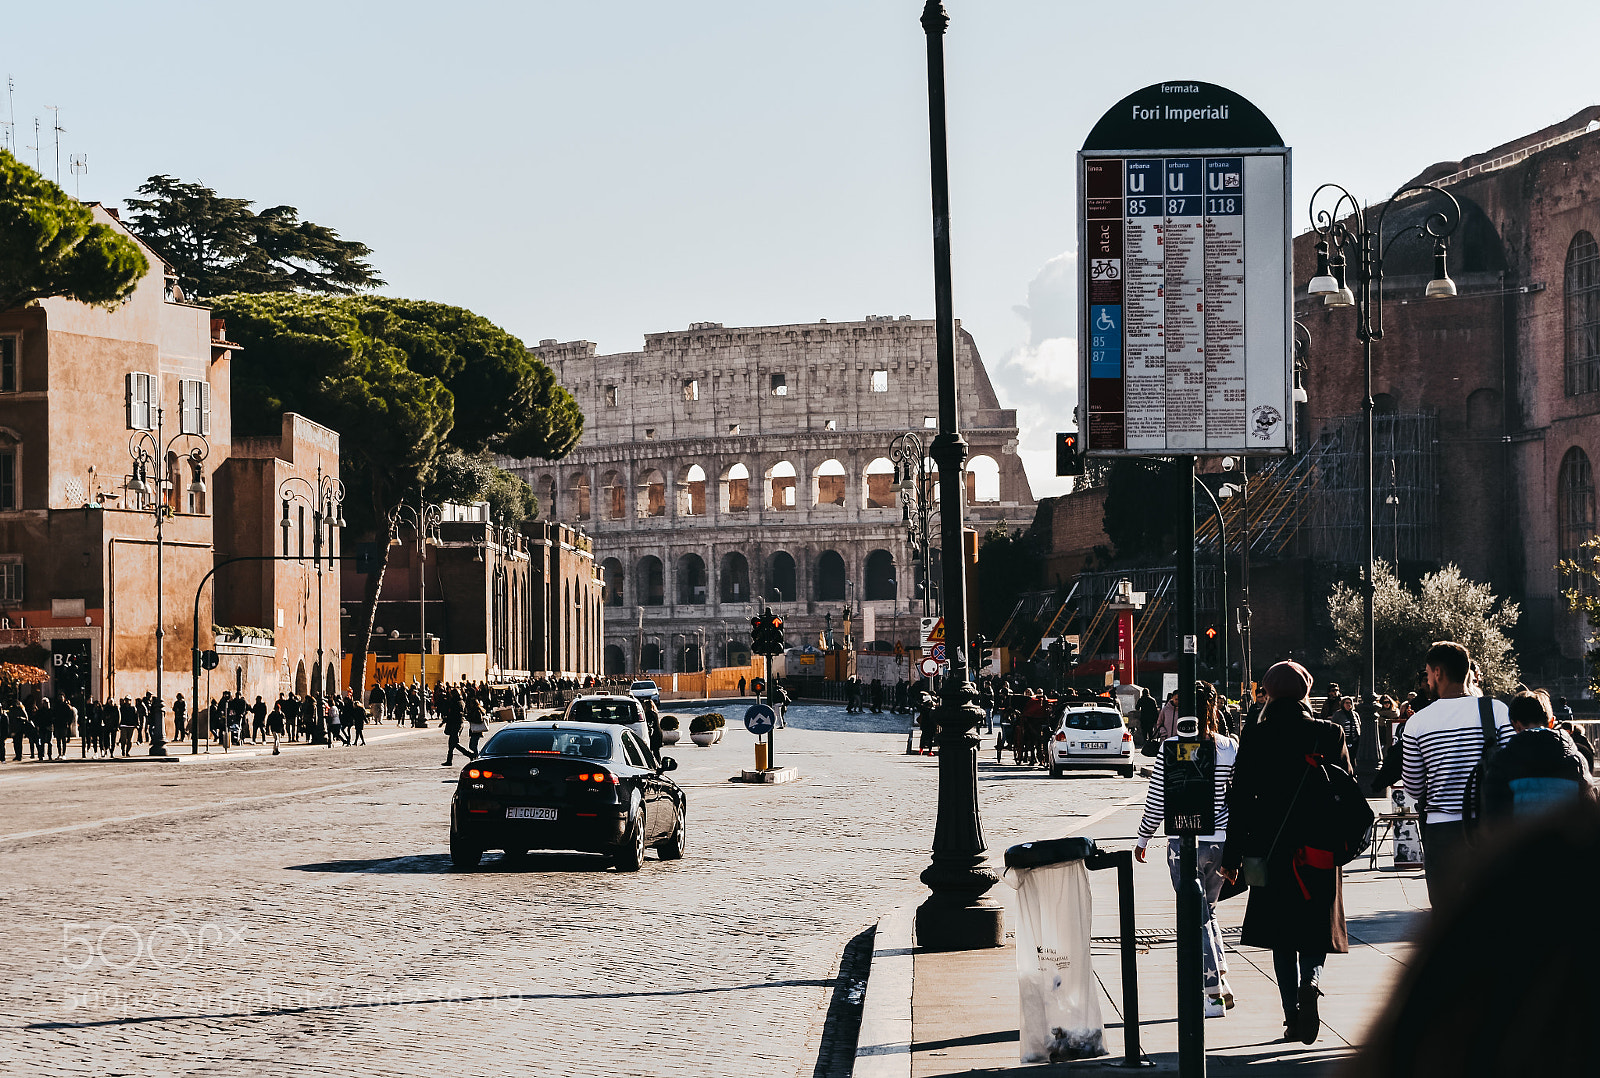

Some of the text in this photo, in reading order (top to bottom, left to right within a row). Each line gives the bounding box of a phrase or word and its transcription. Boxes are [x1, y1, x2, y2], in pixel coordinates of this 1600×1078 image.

[1161, 83, 1199, 93] fermata
[1132, 105, 1229, 122] Fori Imperiali
[1129, 199, 1146, 215] 85
[1168, 199, 1186, 214] 87
[1208, 198, 1235, 213] 118
[1100, 225, 1110, 253] atac
[1093, 336, 1105, 347] 85
[1093, 351, 1105, 362] 87
[1174, 815, 1201, 828] ADNATE
